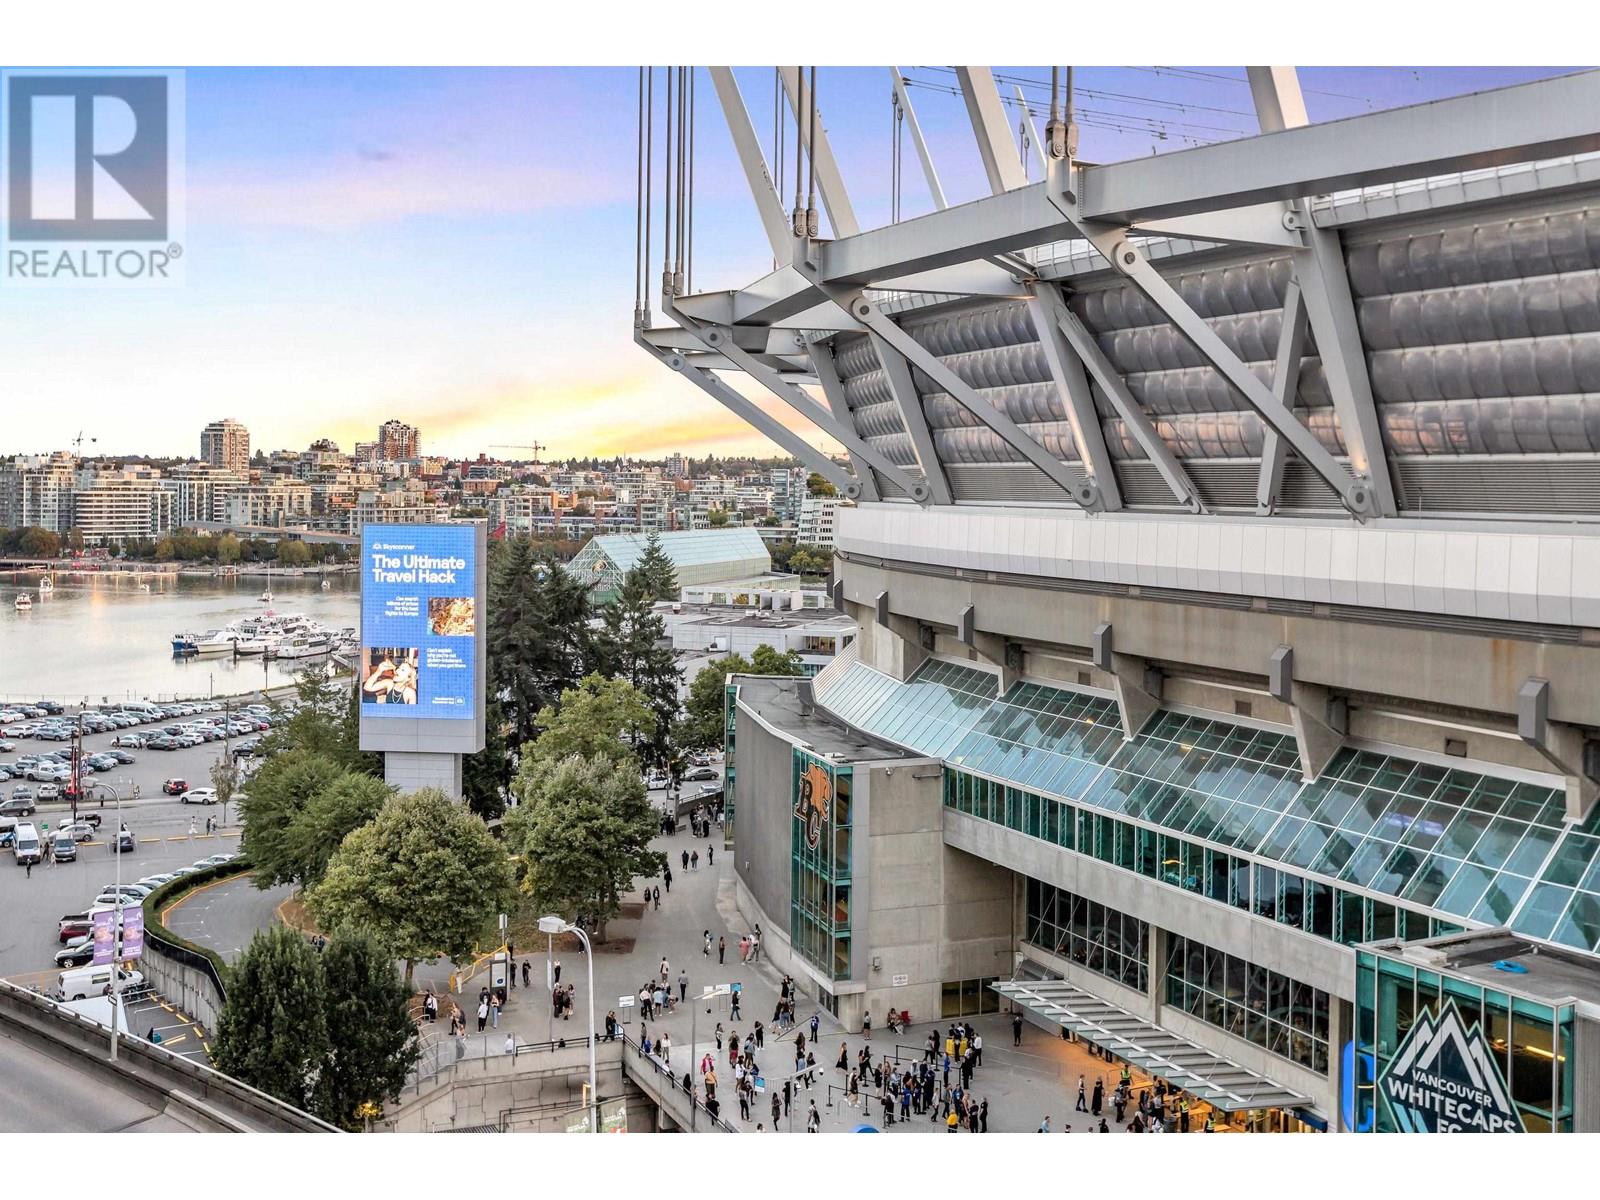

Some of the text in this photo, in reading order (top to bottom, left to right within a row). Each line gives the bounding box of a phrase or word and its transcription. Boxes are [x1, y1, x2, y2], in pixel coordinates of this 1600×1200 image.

[382, 543, 416, 551] Skyscanner
[371, 554, 466, 570] The Ultimate
[371, 568, 456, 584] Travel Hack
[1411, 1069, 1493, 1108] VANCOUVER
[1386, 1076, 1517, 1133] WHITECAPS
